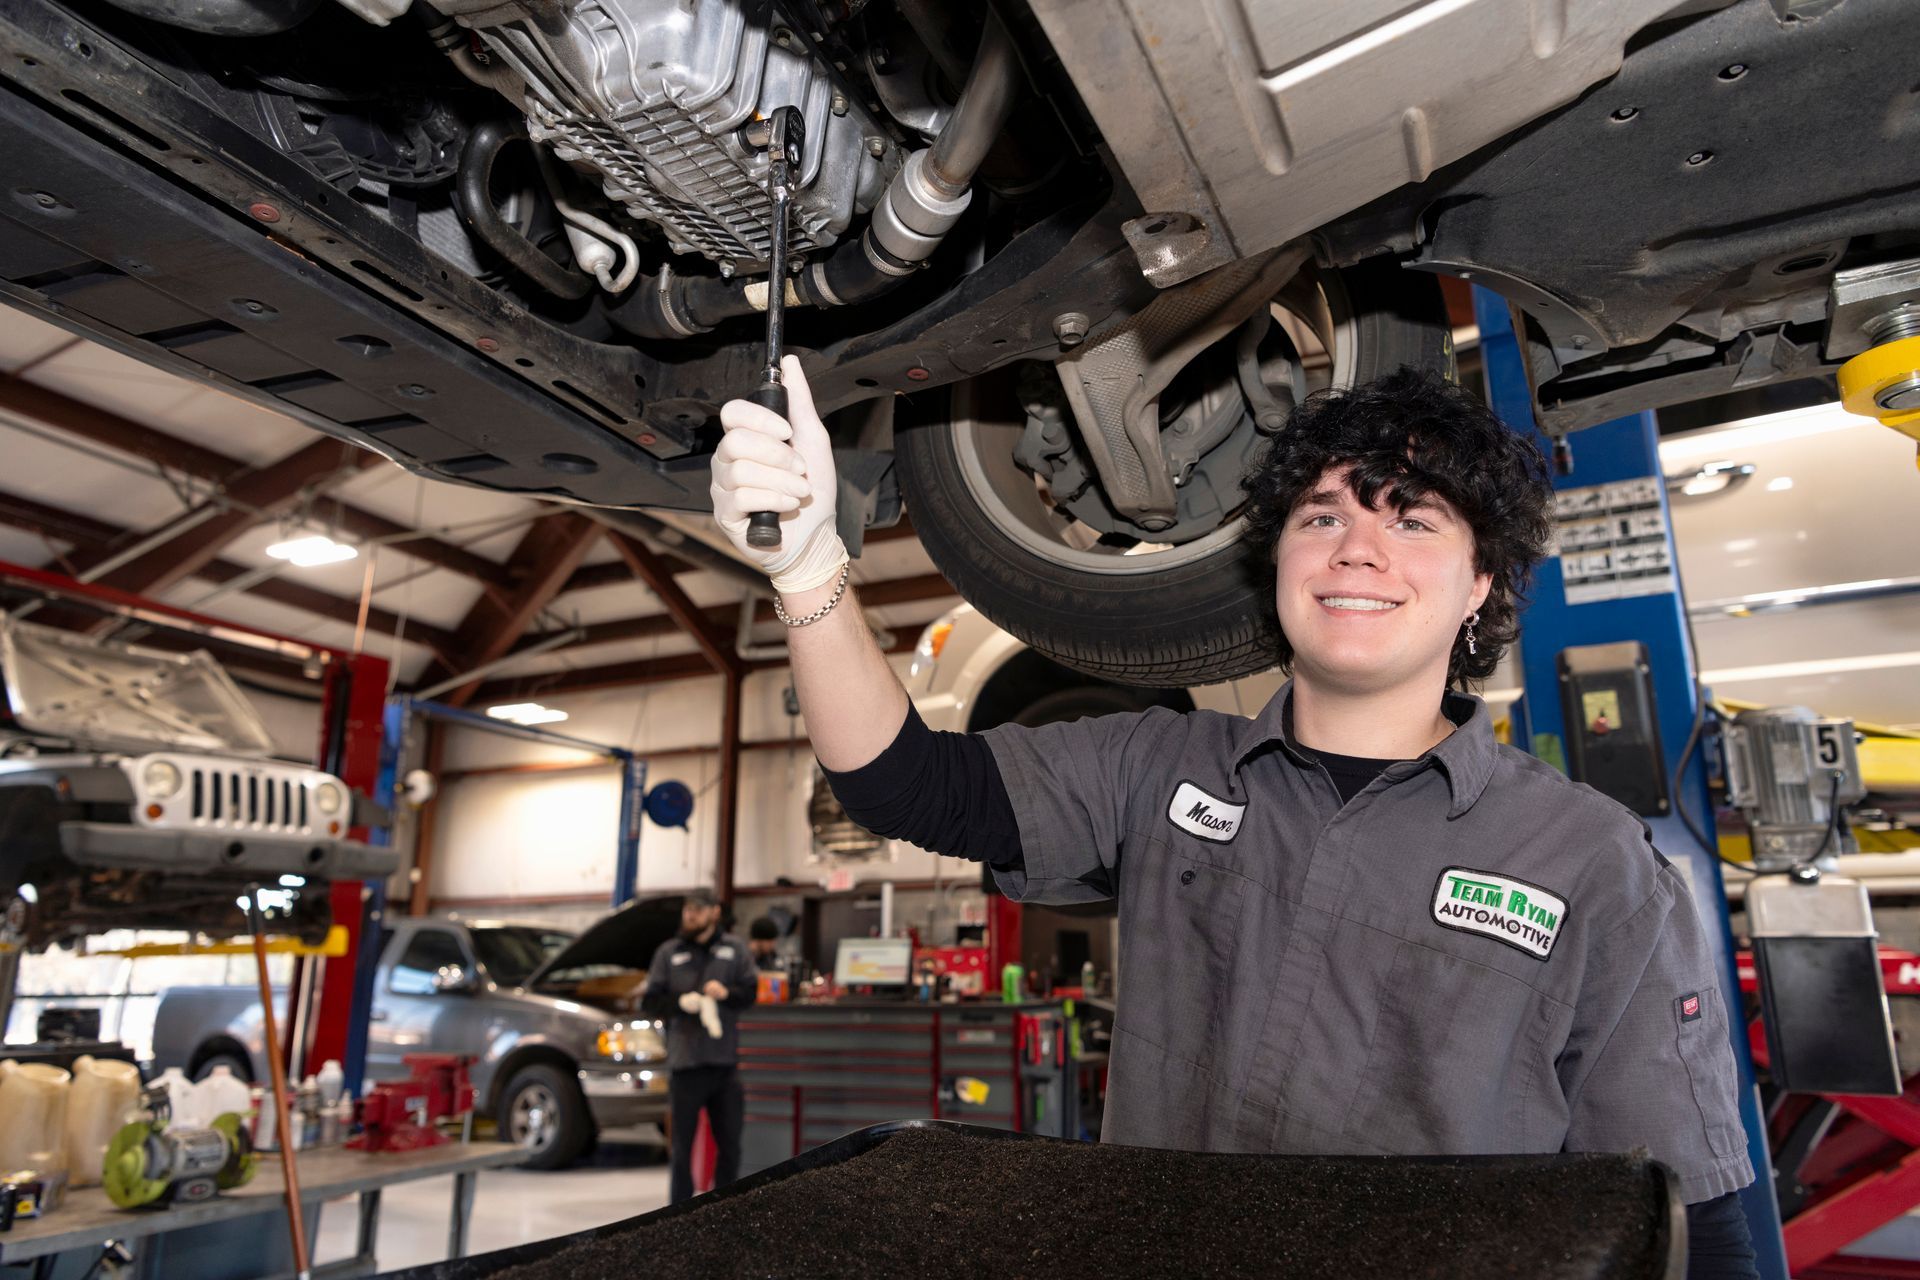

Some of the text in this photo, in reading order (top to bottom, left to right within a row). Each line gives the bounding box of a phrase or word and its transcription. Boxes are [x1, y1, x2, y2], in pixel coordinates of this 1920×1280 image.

[1817, 726, 1838, 764] 5
[1186, 801, 1233, 832] Mason
[1438, 902, 1551, 950] AUTOMOTIVE
